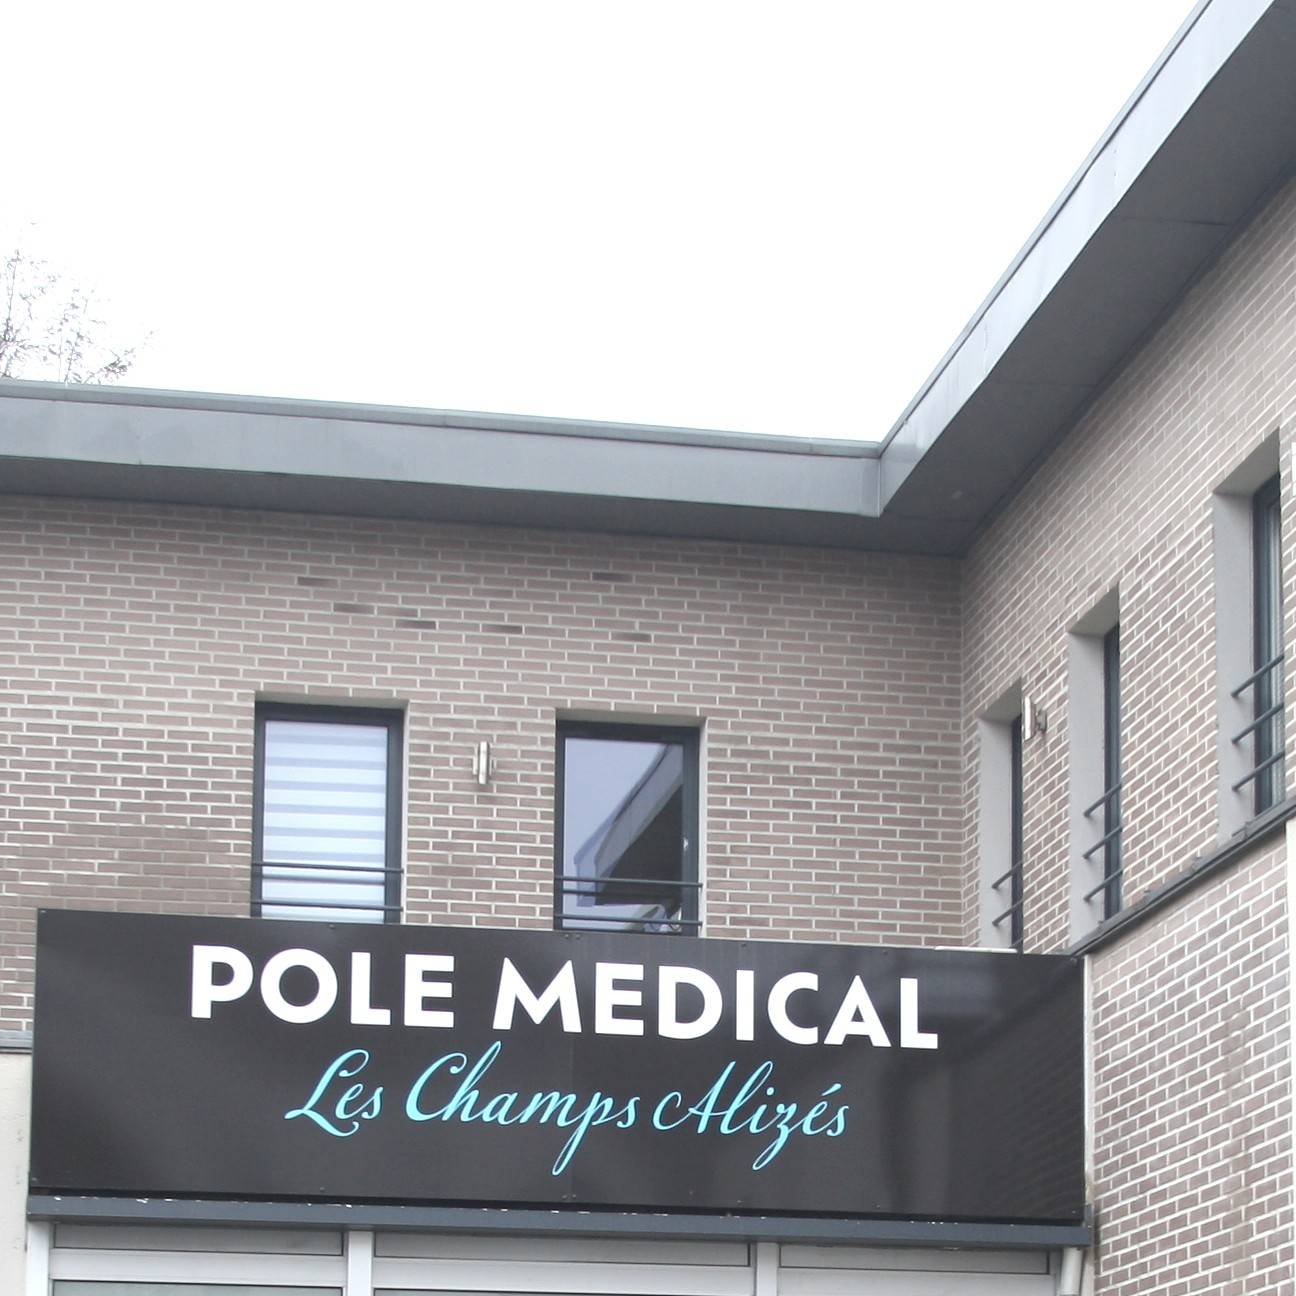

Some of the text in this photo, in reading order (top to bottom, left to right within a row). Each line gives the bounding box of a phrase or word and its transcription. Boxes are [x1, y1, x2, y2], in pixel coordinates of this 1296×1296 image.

[191, 944, 939, 1050] POLE MEDICAL
[285, 1041, 848, 1176] Les Champs Alizés
